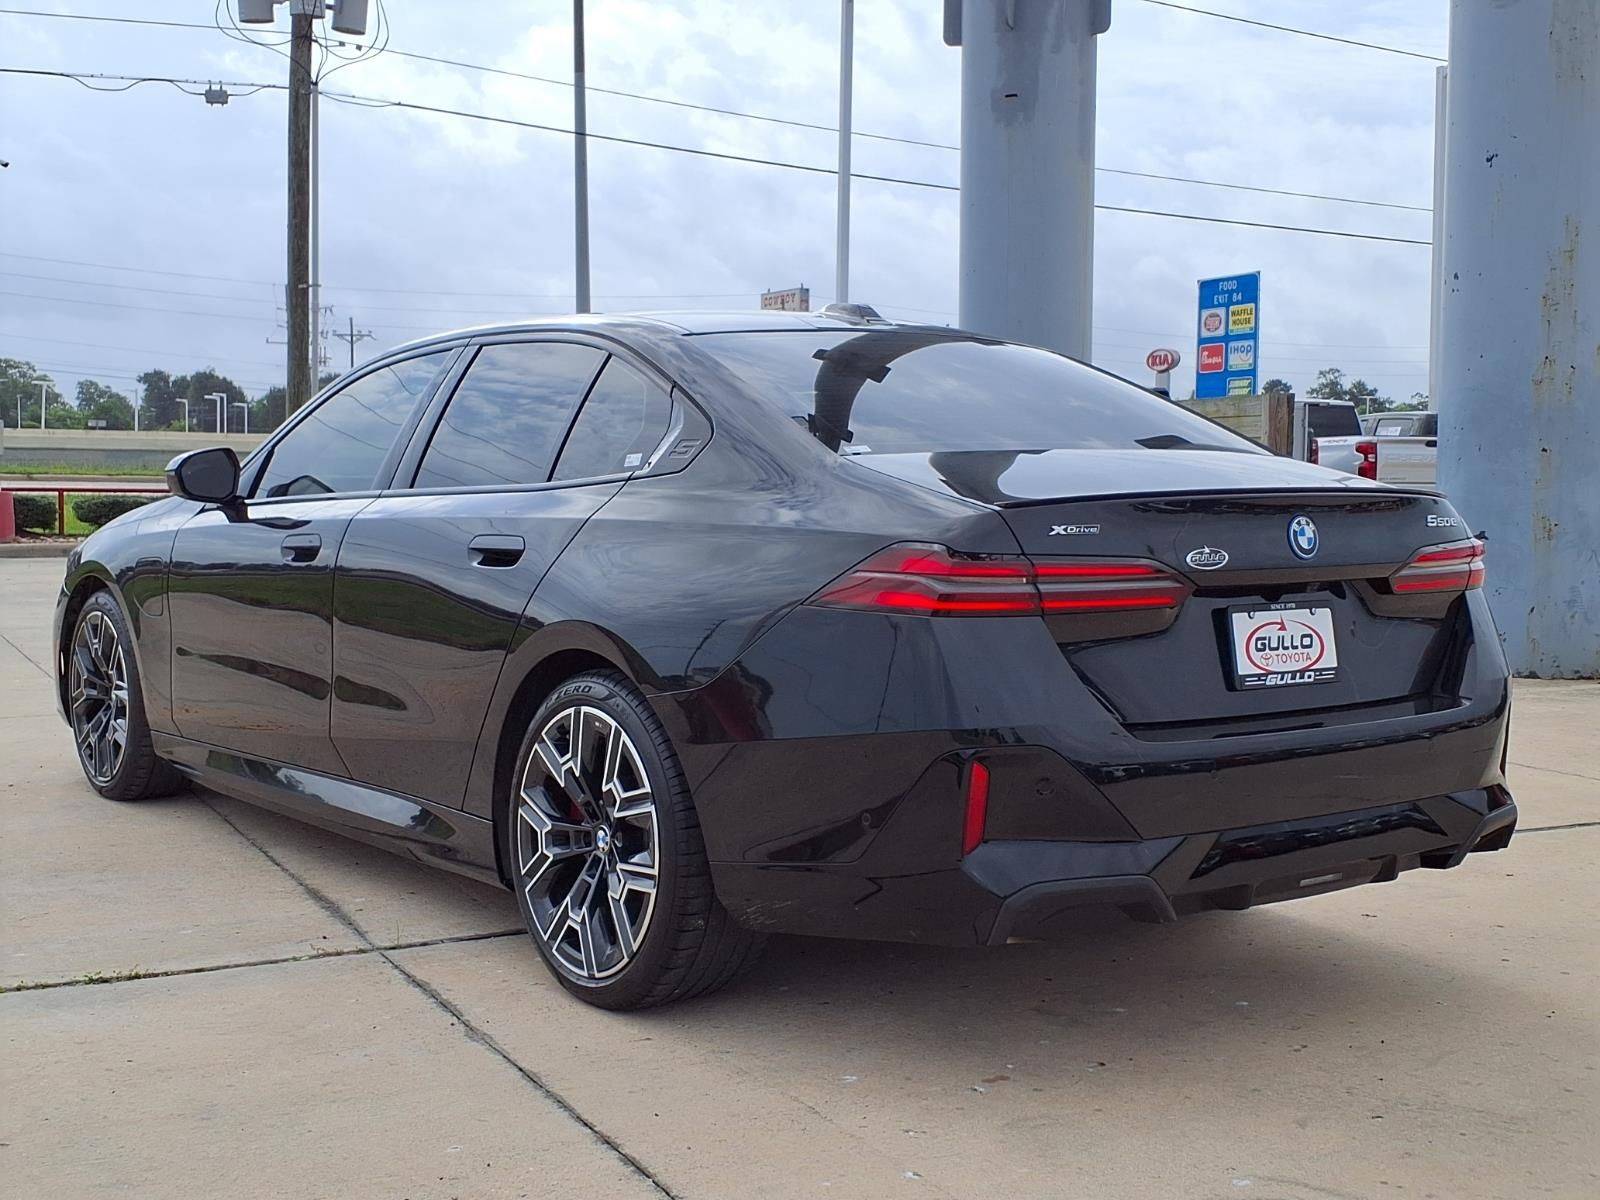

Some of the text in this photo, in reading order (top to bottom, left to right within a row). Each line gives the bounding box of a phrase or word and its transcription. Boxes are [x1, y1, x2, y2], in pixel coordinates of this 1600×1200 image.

[1219, 280, 1237, 291] FOOD
[1231, 307, 1253, 317] WAFFLE
[1231, 317, 1251, 327] HOUSE
[1150, 354, 1170, 366] KIA
[1190, 553, 1225, 564] GULLO
[1254, 633, 1313, 652] GULLO
[1275, 652, 1312, 664] TOYOTA
[1265, 671, 1315, 686] GULLO
